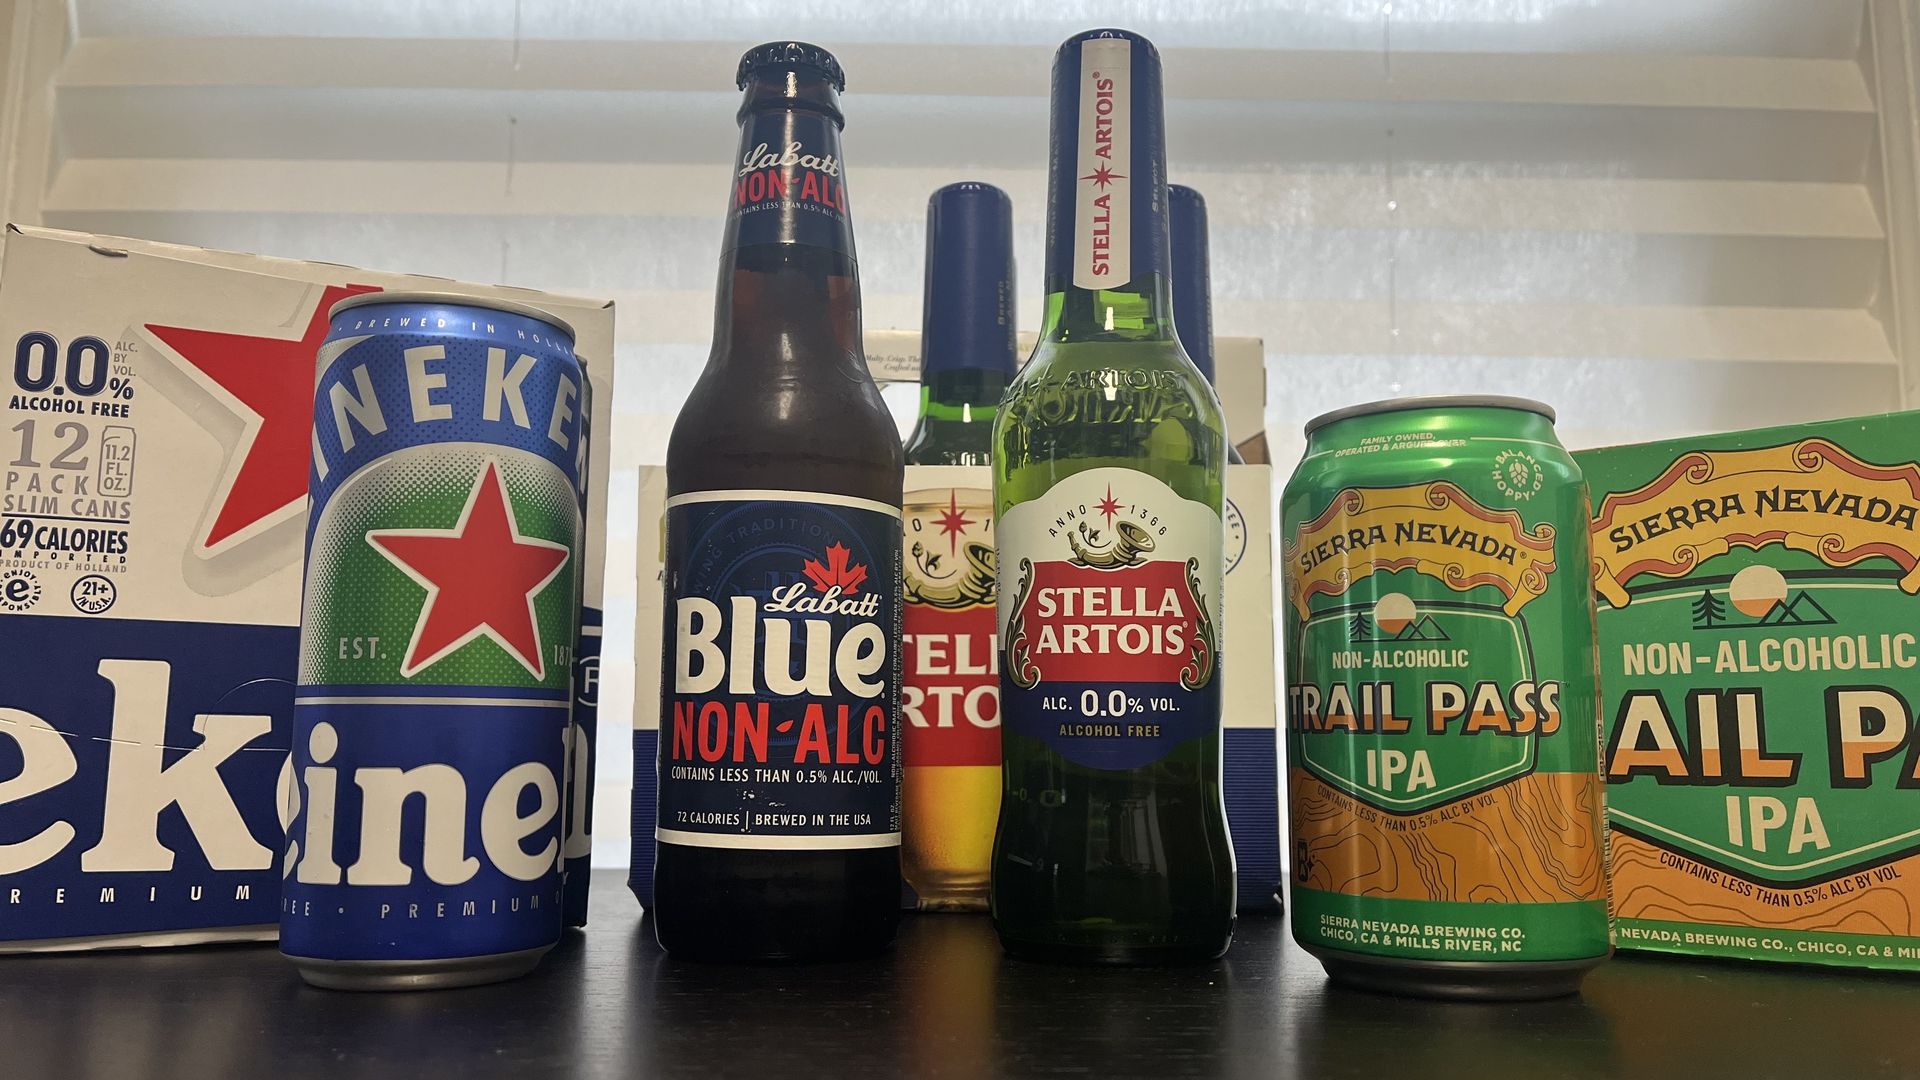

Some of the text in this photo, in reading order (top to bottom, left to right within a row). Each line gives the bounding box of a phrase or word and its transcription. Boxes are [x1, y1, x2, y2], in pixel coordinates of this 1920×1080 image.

[739, 141, 839, 177] Labatt
[1092, 78, 1114, 276] STELLA ARTOIS
[734, 205, 760, 220] ONTAINS
[762, 201, 779, 210] LESS
[115, 340, 138, 353] ALC.
[354, 317, 577, 358] BREWED IN HOLL
[113, 353, 127, 364] BY
[113, 364, 137, 377] VOL.
[9, 395, 130, 418] ALCOHOL FREE
[9, 418, 90, 472] 12
[105, 443, 131, 461] 11.2
[1334, 445, 1380, 458] OPERATED
[1382, 443, 1390, 451] &
[1360, 432, 1436, 446] FAMILY OWNED,
[5, 471, 90, 496] PACK
[103, 476, 127, 492] OZ.
[106, 462, 128, 477] FL.
[1497, 450, 1544, 497] BALANCED
[1492, 470, 1532, 501] HOPPY
[3, 494, 132, 520] SLIM CANS
[1048, 504, 1168, 538] ANNO 1366
[1609, 485, 1920, 554] SIERRA NEVADA
[0, 518, 129, 555] 69 CALORIES
[1300, 519, 1518, 576] SIERRA NEVADA
[56, 562, 70, 571] OF
[76, 563, 128, 574] HOLLAND
[0, 580, 42, 612] PONSIBLY
[76, 596, 90, 607] IN
[82, 581, 109, 596] 21+
[764, 582, 880, 618] Labatt
[1036, 586, 1185, 618] STELLA
[338, 636, 388, 661] EST.
[675, 595, 886, 699] Blue
[1035, 623, 1185, 655] ARTOIS
[553, 644, 573, 668] 187
[1331, 648, 1469, 670] NON-ALCOHOLIC
[1622, 632, 1918, 676] NON-ALCOHOLIC
[1042, 689, 1181, 717] ALC. 0.0% VOL.
[1289, 680, 1562, 737] TRAIL PASS
[672, 700, 885, 765] NON-ALC
[1059, 723, 1161, 738] ALCOHOL FREE
[1823, 684, 1920, 790] P
[0, 658, 292, 876] ek
[671, 765, 883, 785] CONTAINS LESS THAN 0.5% ALC./VOL.
[1366, 749, 1437, 793] IPA
[282, 720, 575, 886] ine
[1316, 784, 1499, 832] CONTAINS LESS THAN 0.5% ALC BY VOL
[677, 811, 872, 826] 72 CALORIES BREWED IN THE USA
[1725, 795, 1832, 855] IPA
[10, 885, 250, 904] REMIUM
[1659, 852, 1902, 908] CONTAINS LESS THAN 0.5% ALC BY VOL
[381, 895, 540, 919] PREMIUM
[1320, 914, 1526, 939] SIERRA NEVADA BREWING CO.
[1320, 926, 1522, 954] CHICO, CA & MILLS RIVER, NC
[1621, 927, 1682, 942] NEVADA
[1685, 933, 1757, 949] BREWING
[1761, 938, 1794, 954] CO.,
[1797, 940, 1852, 956] CHICO,
[1856, 944, 1878, 956] CA
[1883, 945, 1893, 957] &
